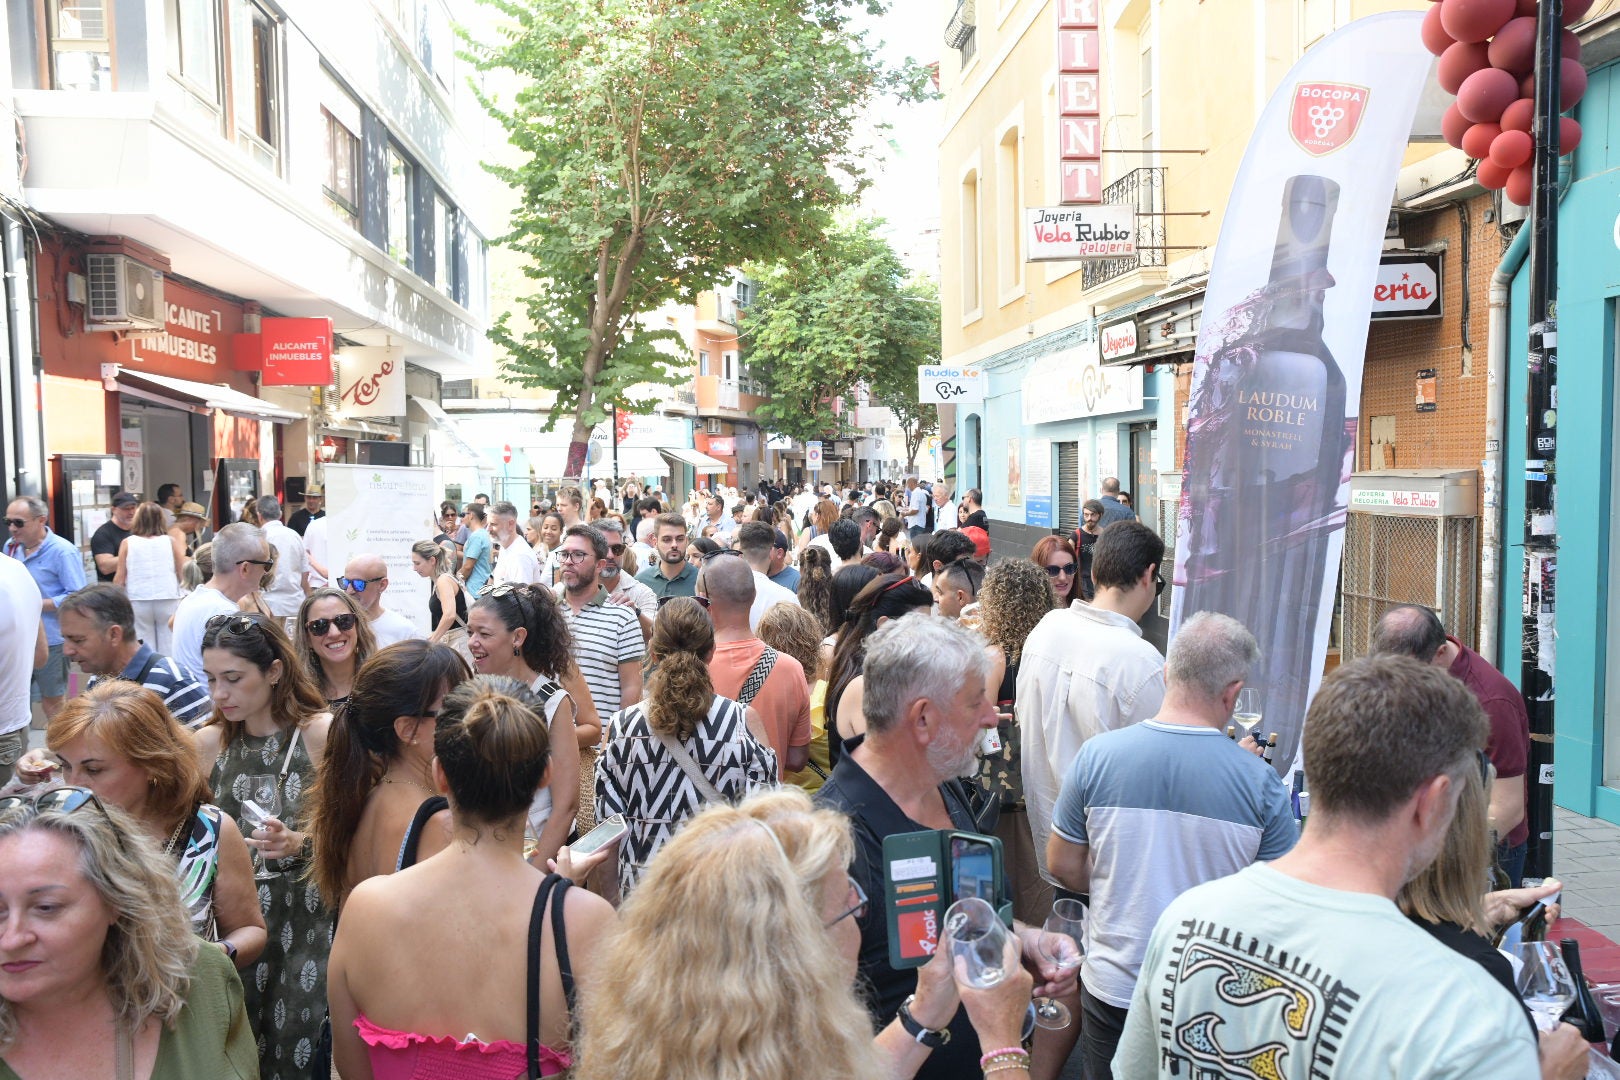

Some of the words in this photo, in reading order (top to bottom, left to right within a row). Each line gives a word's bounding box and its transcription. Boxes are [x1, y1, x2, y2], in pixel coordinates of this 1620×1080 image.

[1301, 87, 1360, 102] BOCOPA
[1034, 224, 1072, 242] Vela
[1075, 223, 1130, 241] Rubio
[141, 333, 216, 364] INMUEBLES
[273, 342, 319, 350] ALICANTE
[270, 352, 322, 360] INMUEBLES
[924, 368, 959, 377] Audio
[1238, 390, 1317, 411] LAUDUM
[1247, 406, 1306, 426] ROBLE
[1392, 491, 1409, 506] Vela
[1411, 492, 1437, 507] Rubio
